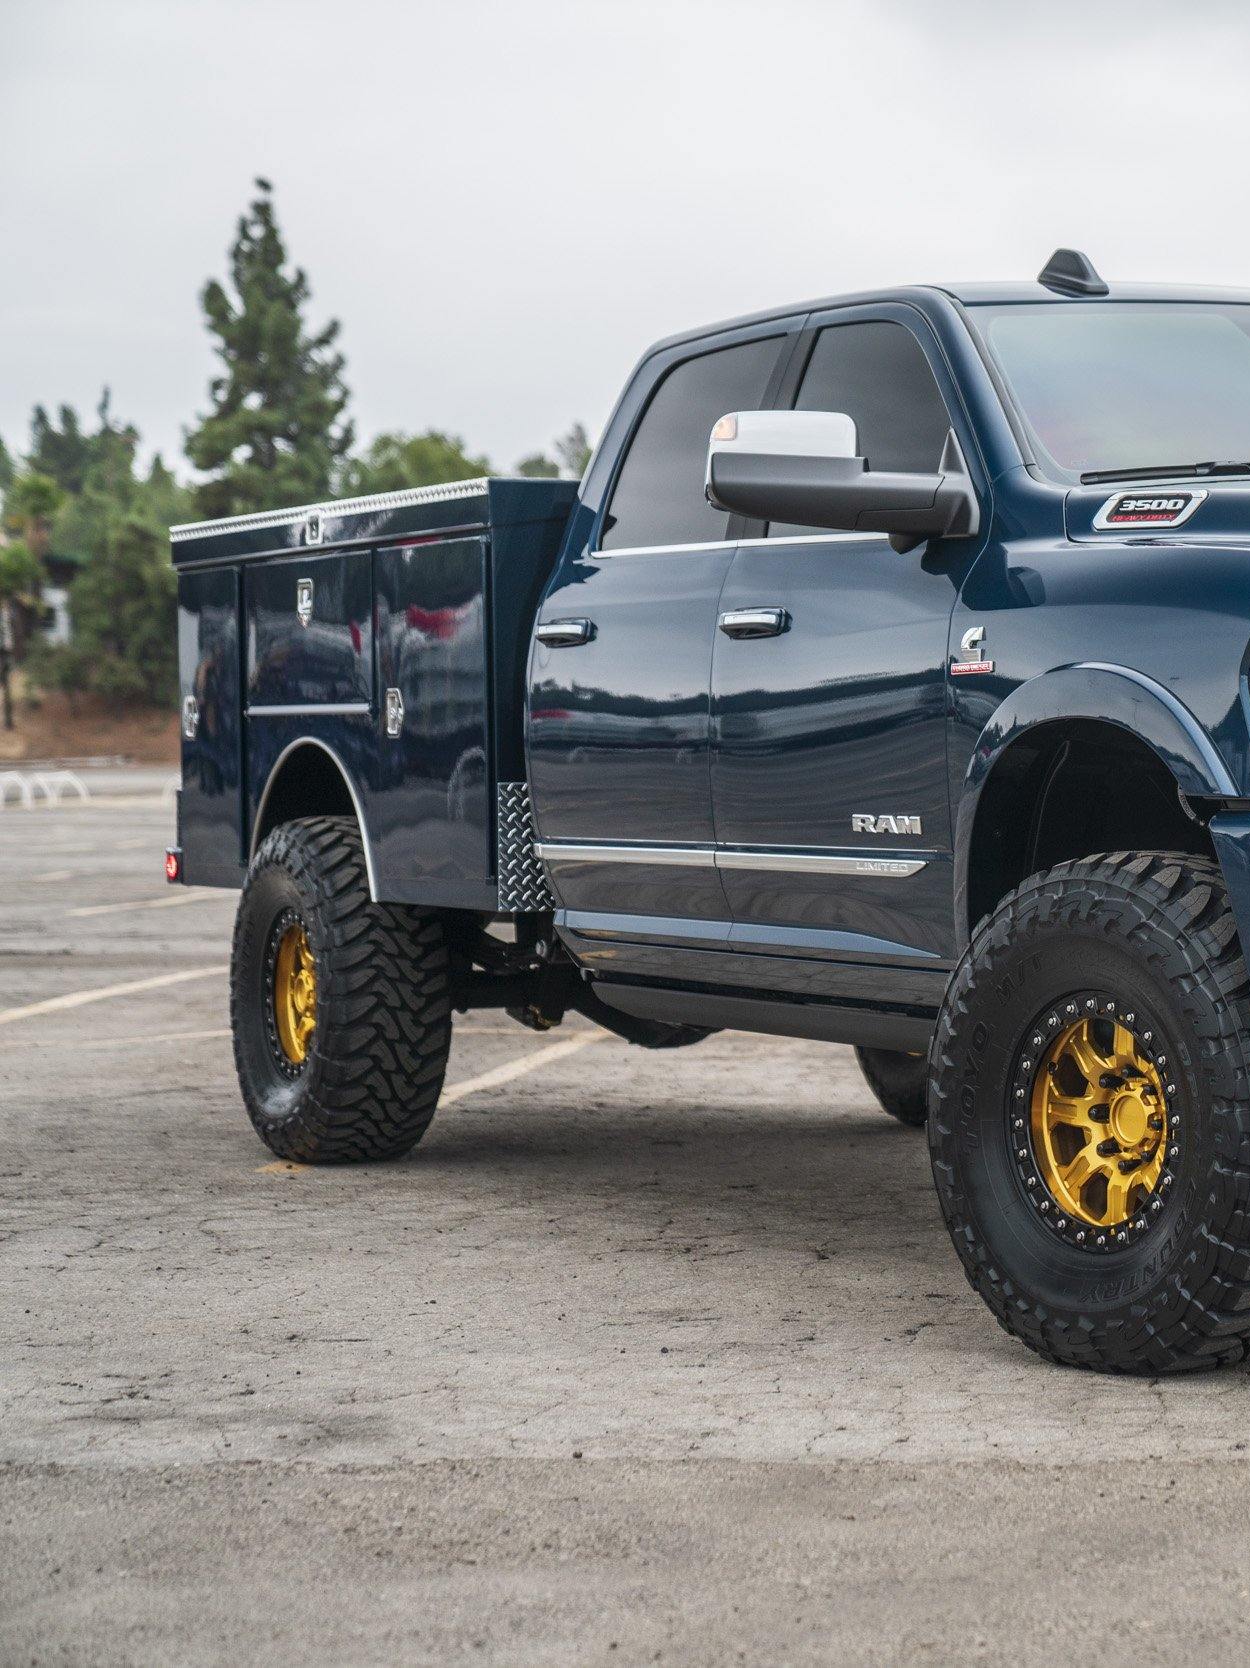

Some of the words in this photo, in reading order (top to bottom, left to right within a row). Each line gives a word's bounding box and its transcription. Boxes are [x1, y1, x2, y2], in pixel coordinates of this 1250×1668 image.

[1119, 499, 1185, 512] 3500
[852, 813, 922, 835] RAM
[856, 861, 909, 873] LIMITED
